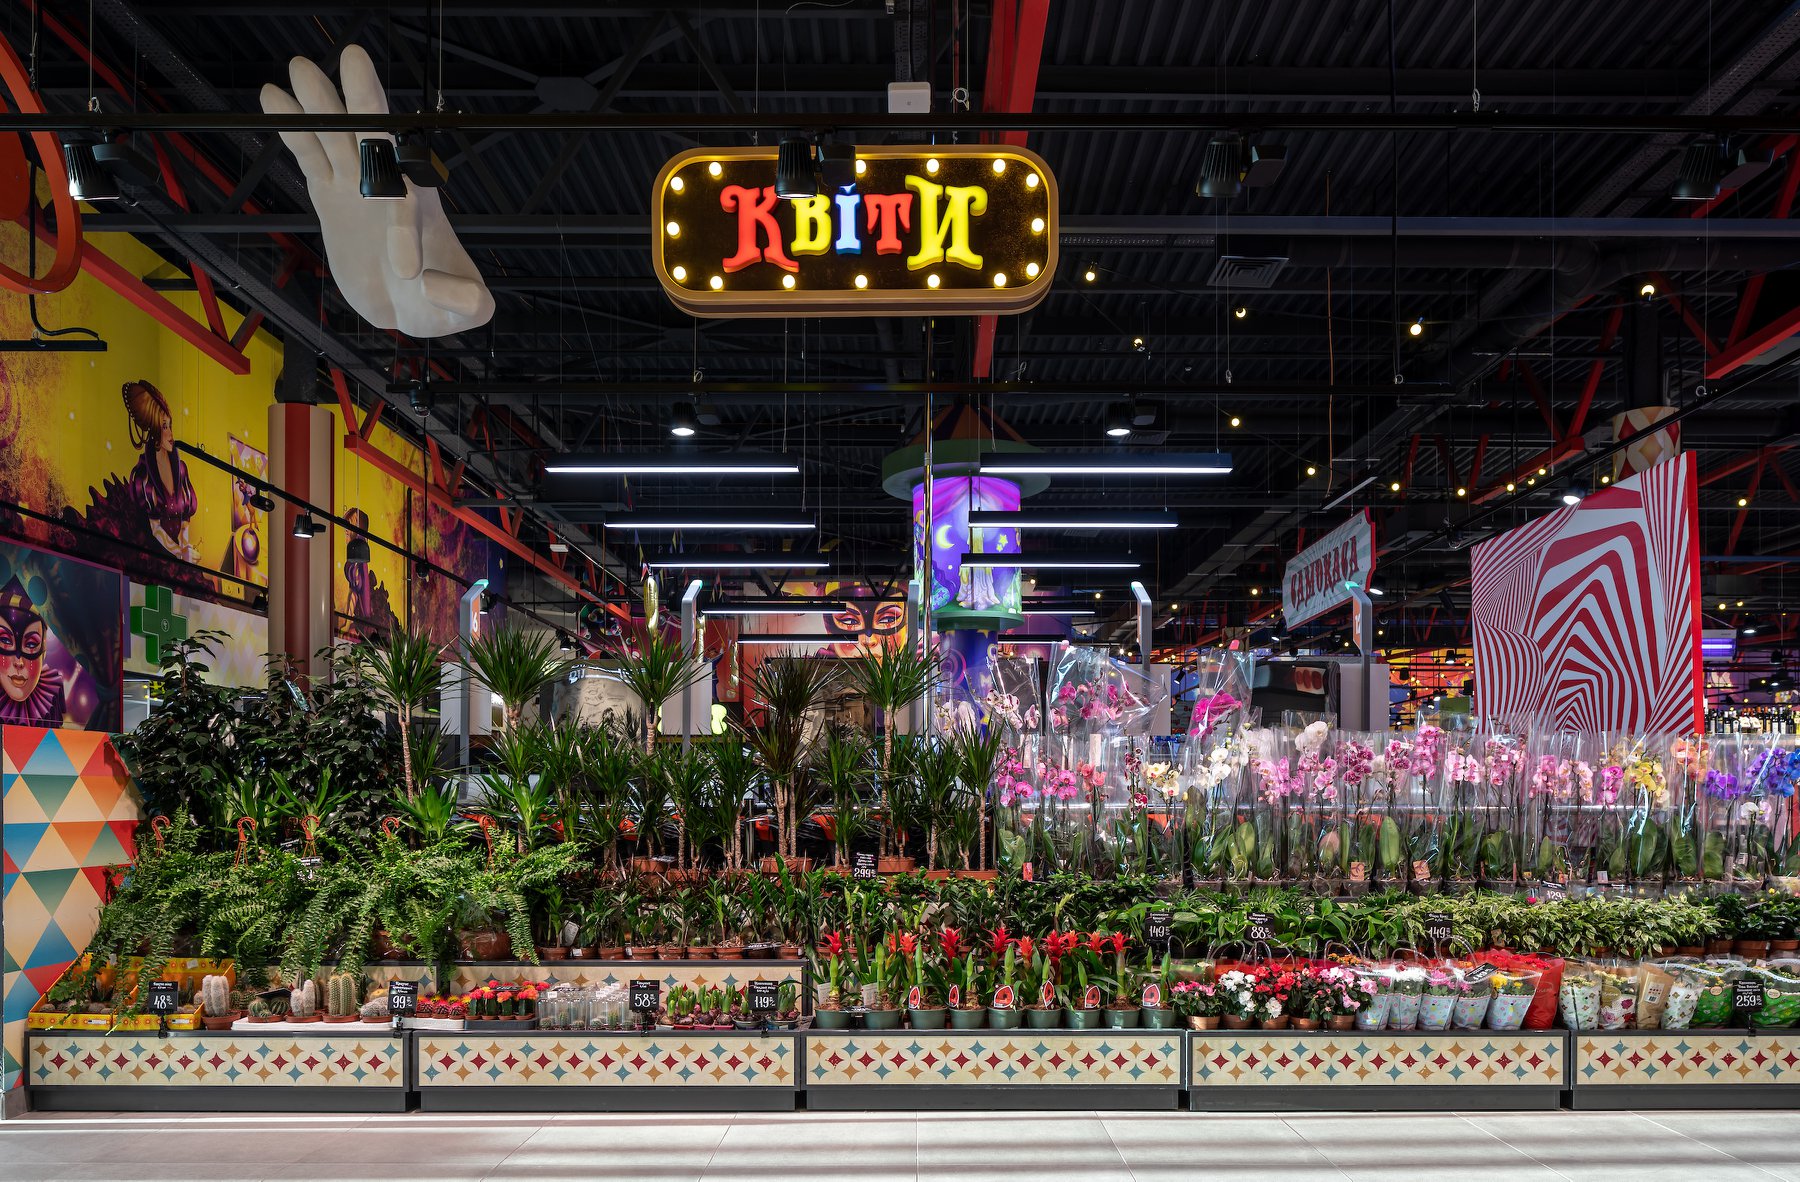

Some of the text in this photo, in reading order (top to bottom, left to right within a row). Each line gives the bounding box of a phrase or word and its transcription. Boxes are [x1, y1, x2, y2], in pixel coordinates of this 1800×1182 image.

[719, 175, 988, 273] КВІТИ
[1290, 536, 1360, 612] САМОКАСА
[854, 867, 871, 878] 299
[1149, 925, 1165, 938] 149
[1251, 926, 1266, 939] 88
[1429, 926, 1446, 939] 149
[153, 995, 167, 1009] 48
[392, 995, 406, 1009] 99
[634, 993, 651, 1008] 58
[755, 995, 770, 1009] 119
[1736, 994, 1756, 1007] 259
